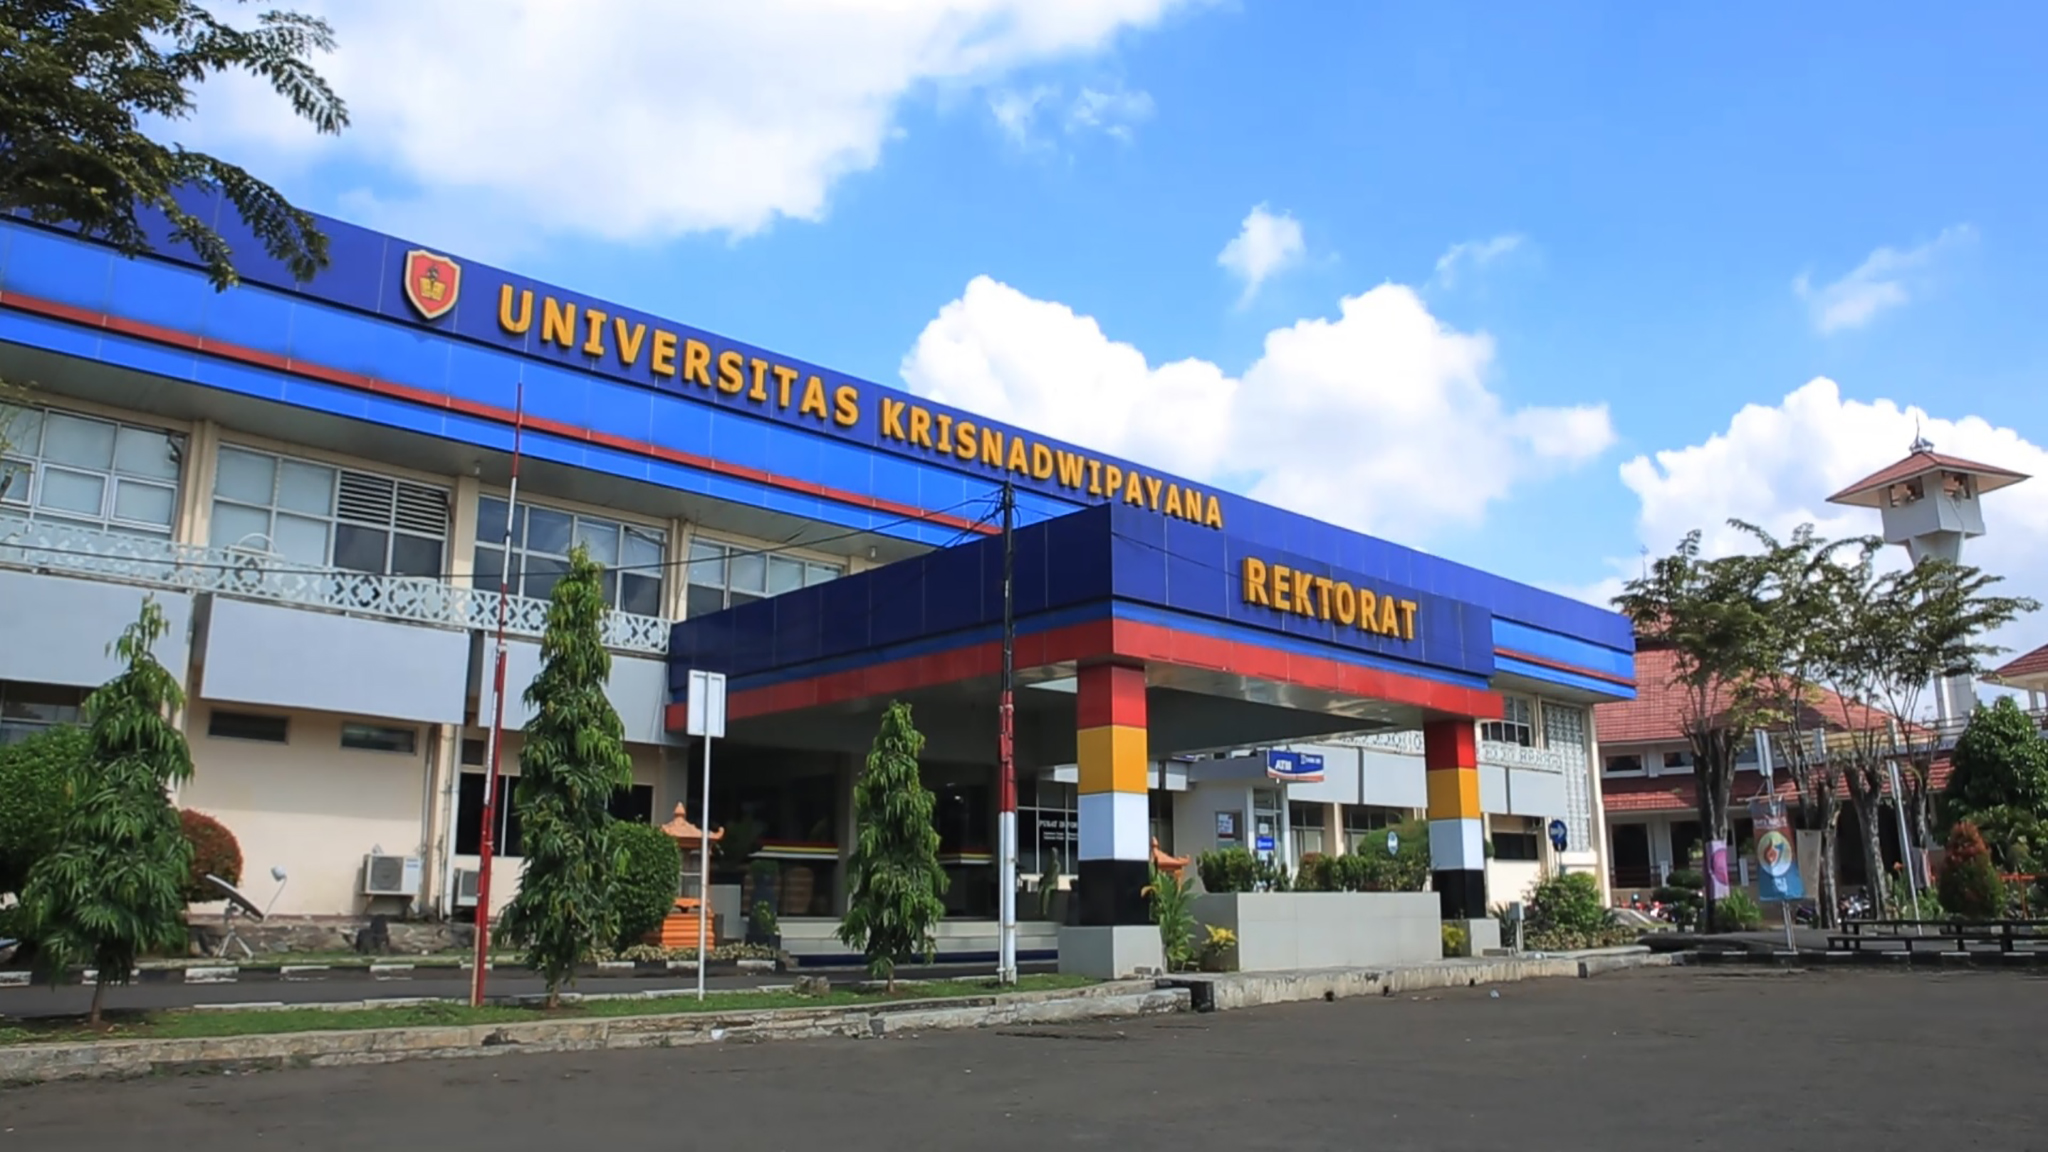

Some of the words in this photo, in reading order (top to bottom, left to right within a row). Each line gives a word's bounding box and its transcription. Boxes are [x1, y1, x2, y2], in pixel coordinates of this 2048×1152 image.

[498, 283, 860, 426] UNIVERSITAS
[882, 397, 1223, 528] KRISNADWIPAYANA
[1243, 556, 1417, 640] REKTORAT
[1275, 759, 1292, 771] ATM
